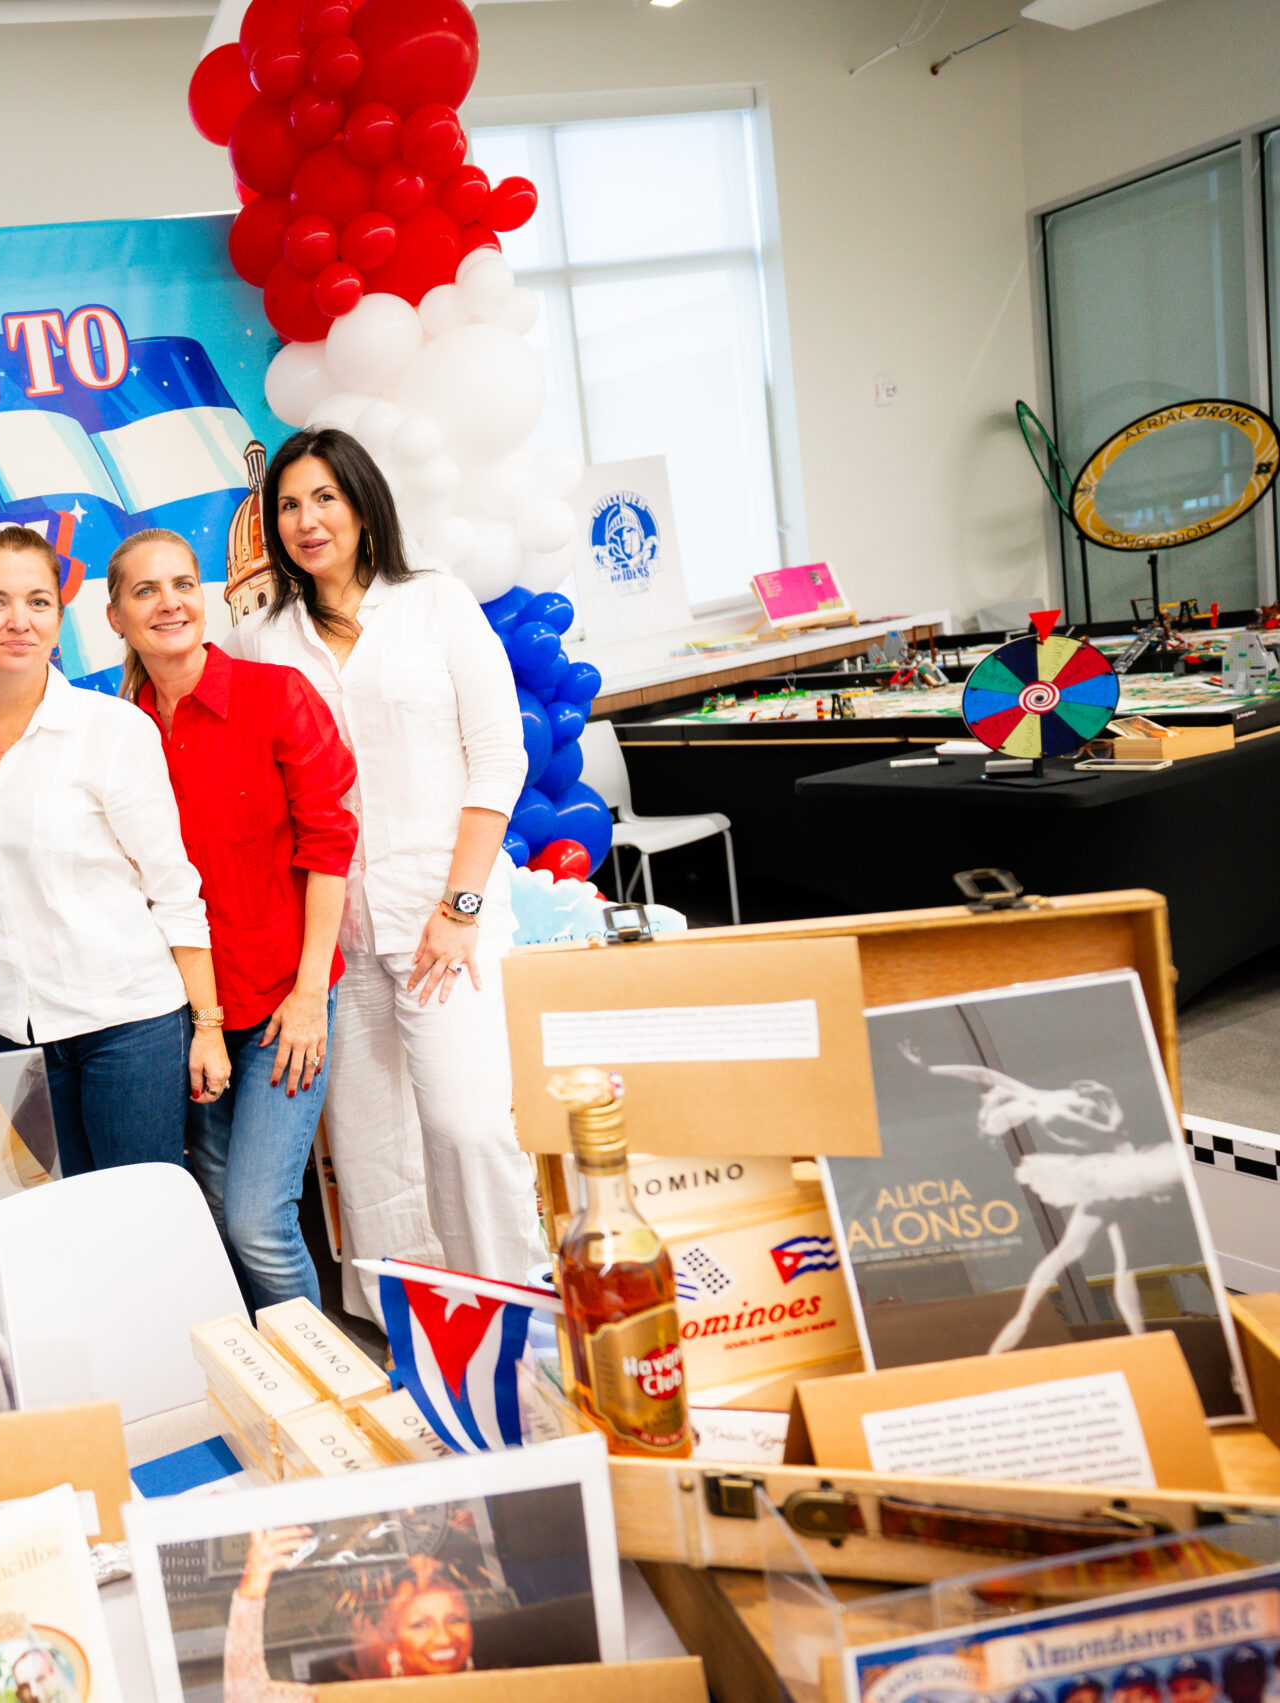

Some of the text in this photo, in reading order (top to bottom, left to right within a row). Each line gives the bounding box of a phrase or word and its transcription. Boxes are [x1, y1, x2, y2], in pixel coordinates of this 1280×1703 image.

[7, 306, 128, 398] TO
[1125, 405, 1256, 442] AERIAL DRONE
[1102, 522, 1212, 548] COMPETITION
[875, 1178, 972, 1211] ALICIA
[845, 1199, 1019, 1251] ALONSO
[680, 1294, 822, 1340] ominoes
[224, 1337, 279, 1392] DOMINO
[294, 1322, 351, 1375] DOMINO
[622, 1347, 682, 1377] Havan
[642, 1368, 683, 1396] Club
[320, 1434, 361, 1470] DOM
[402, 1414, 454, 1458] MINO
